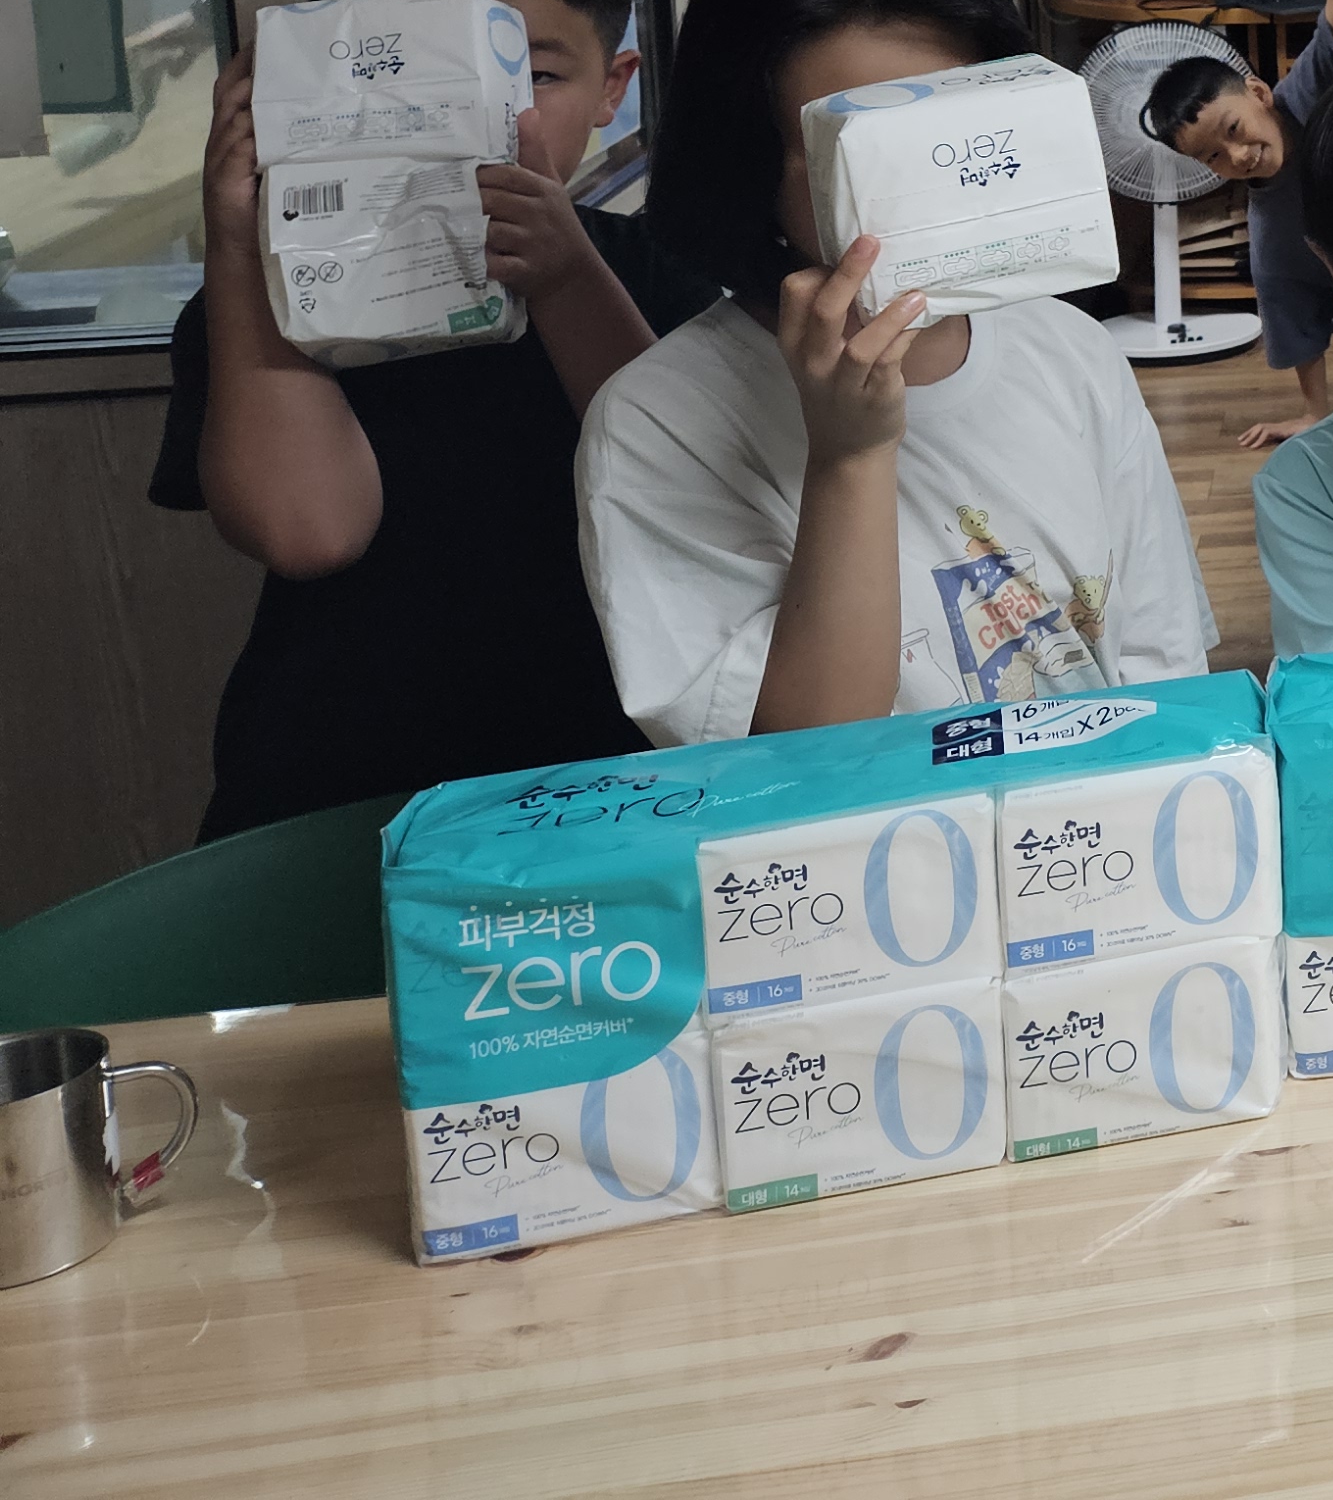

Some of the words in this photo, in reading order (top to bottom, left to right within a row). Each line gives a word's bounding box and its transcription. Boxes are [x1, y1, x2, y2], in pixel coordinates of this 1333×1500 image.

[329, 32, 402, 63] zero
[932, 128, 1017, 168] zero
[946, 736, 993, 759] 대형
[1014, 820, 1101, 860] 순수한면
[714, 863, 807, 904] 순수한면
[1017, 851, 1134, 897] zero
[459, 901, 595, 951] 피부걱정
[718, 893, 843, 942] zero
[461, 941, 661, 1021] zero
[469, 1034, 519, 1060] 100%
[1016, 1011, 1104, 1051] 순수한면
[731, 1052, 826, 1094] 순수한면
[1019, 1040, 1137, 1088] zero
[423, 1103, 521, 1144] 순수한면
[734, 1082, 860, 1134] zero
[428, 1133, 560, 1184] zero
